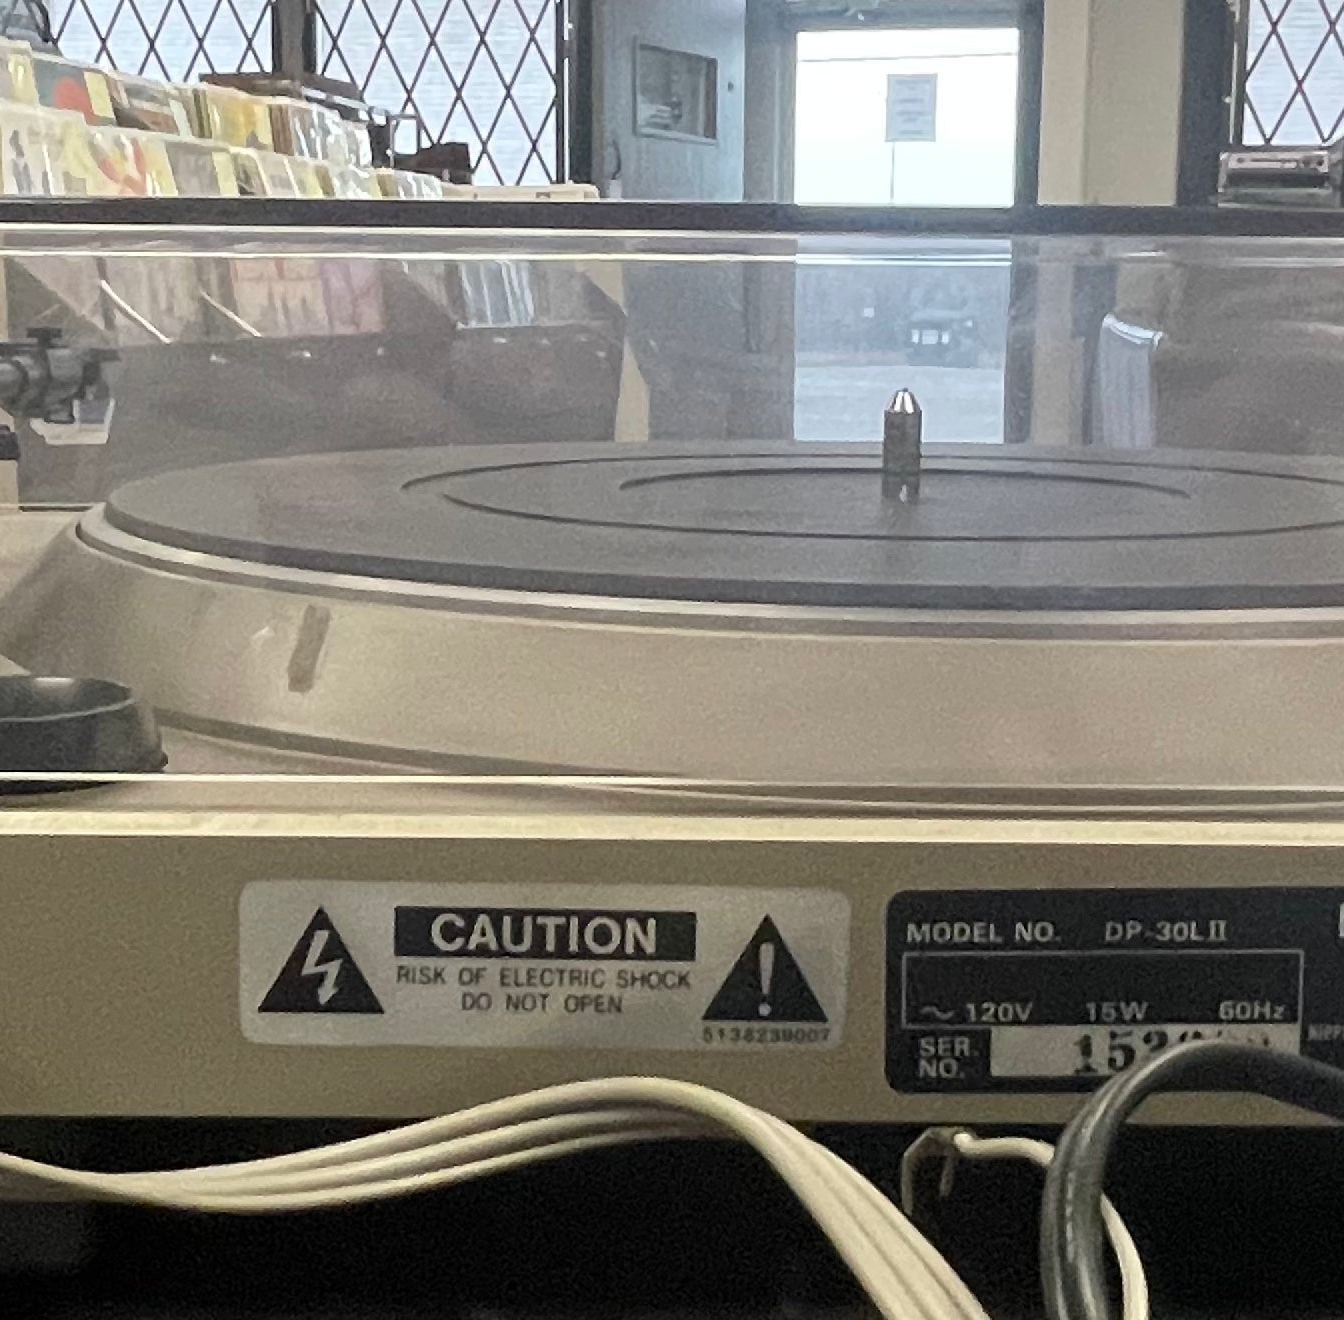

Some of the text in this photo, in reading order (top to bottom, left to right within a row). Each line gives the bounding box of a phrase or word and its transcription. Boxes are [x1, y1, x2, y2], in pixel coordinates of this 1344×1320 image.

[431, 912, 657, 955] CAUTION
[907, 922, 1002, 943] MODEL
[1014, 921, 1060, 943] NO.
[397, 965, 691, 990] RISK OF ELECTRIC SHOCK
[461, 992, 623, 1014] DO NOT OPEN
[965, 1002, 1286, 1023] 120V 15W 60Hz
[919, 1057, 966, 1079] NO.
